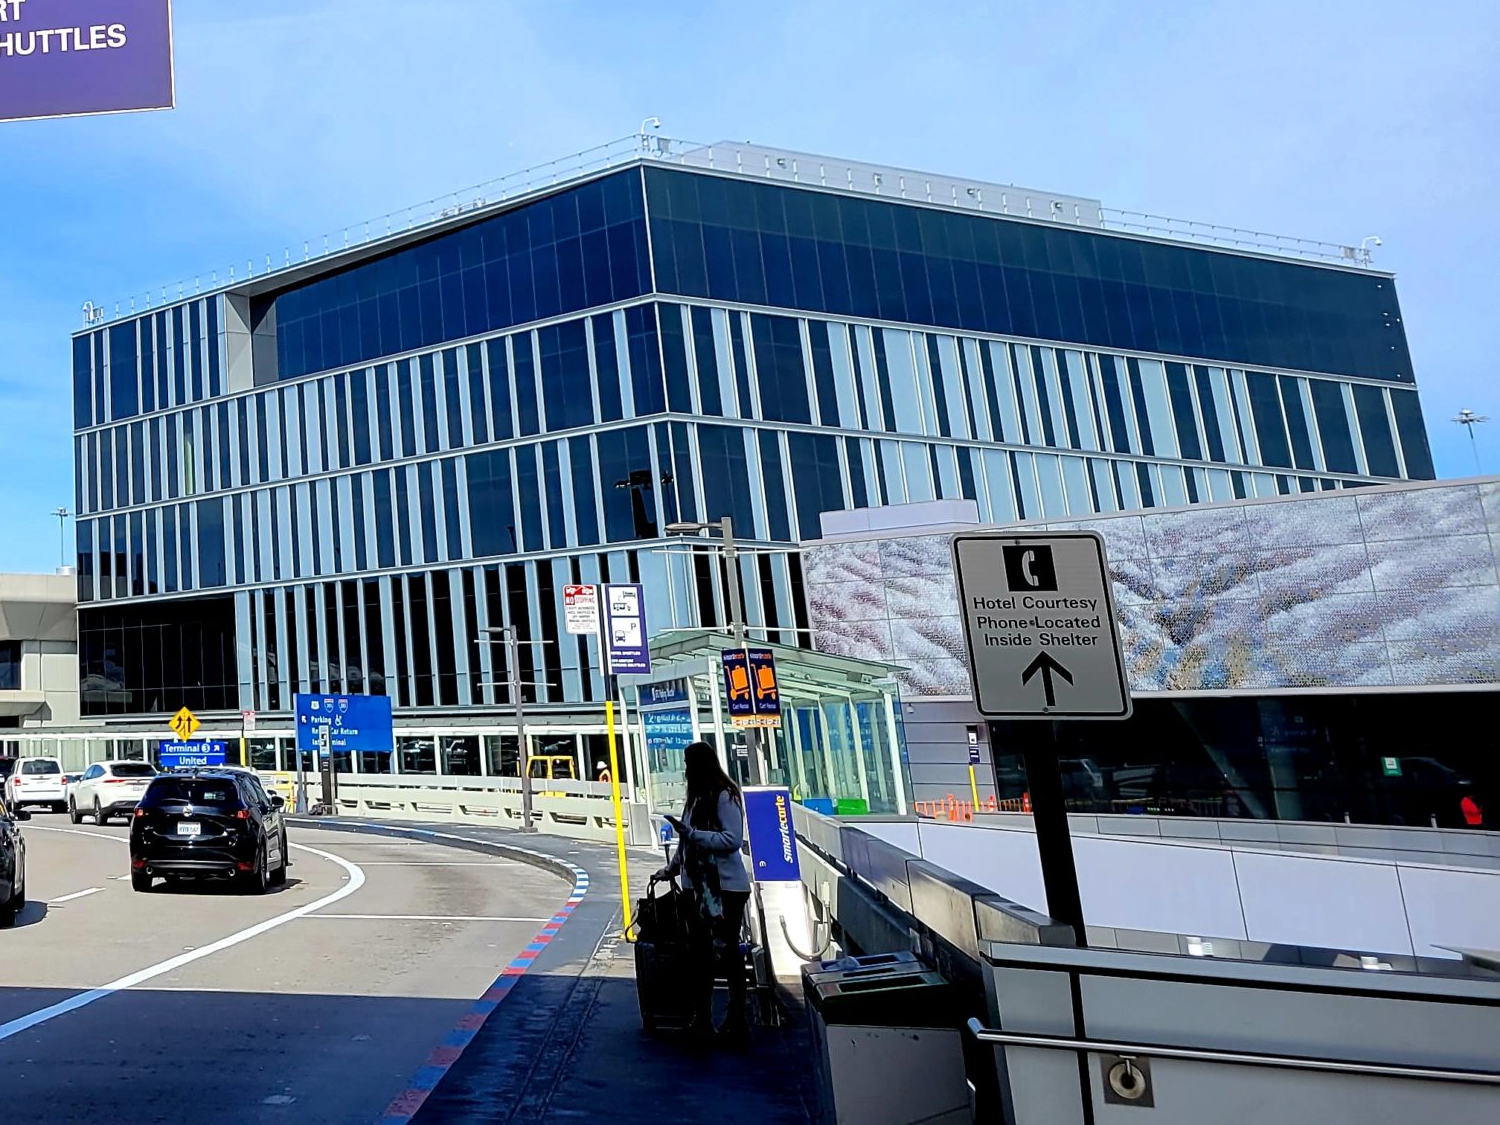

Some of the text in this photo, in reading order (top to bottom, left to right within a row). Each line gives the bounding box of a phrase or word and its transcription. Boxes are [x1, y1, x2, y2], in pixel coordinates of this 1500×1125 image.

[972, 595, 1098, 612] Hotel Courtesy
[976, 615, 1100, 629] Phone Located
[984, 632, 1098, 646] Inside Shelter
[164, 744, 200, 753] Terminal
[179, 756, 208, 765] United
